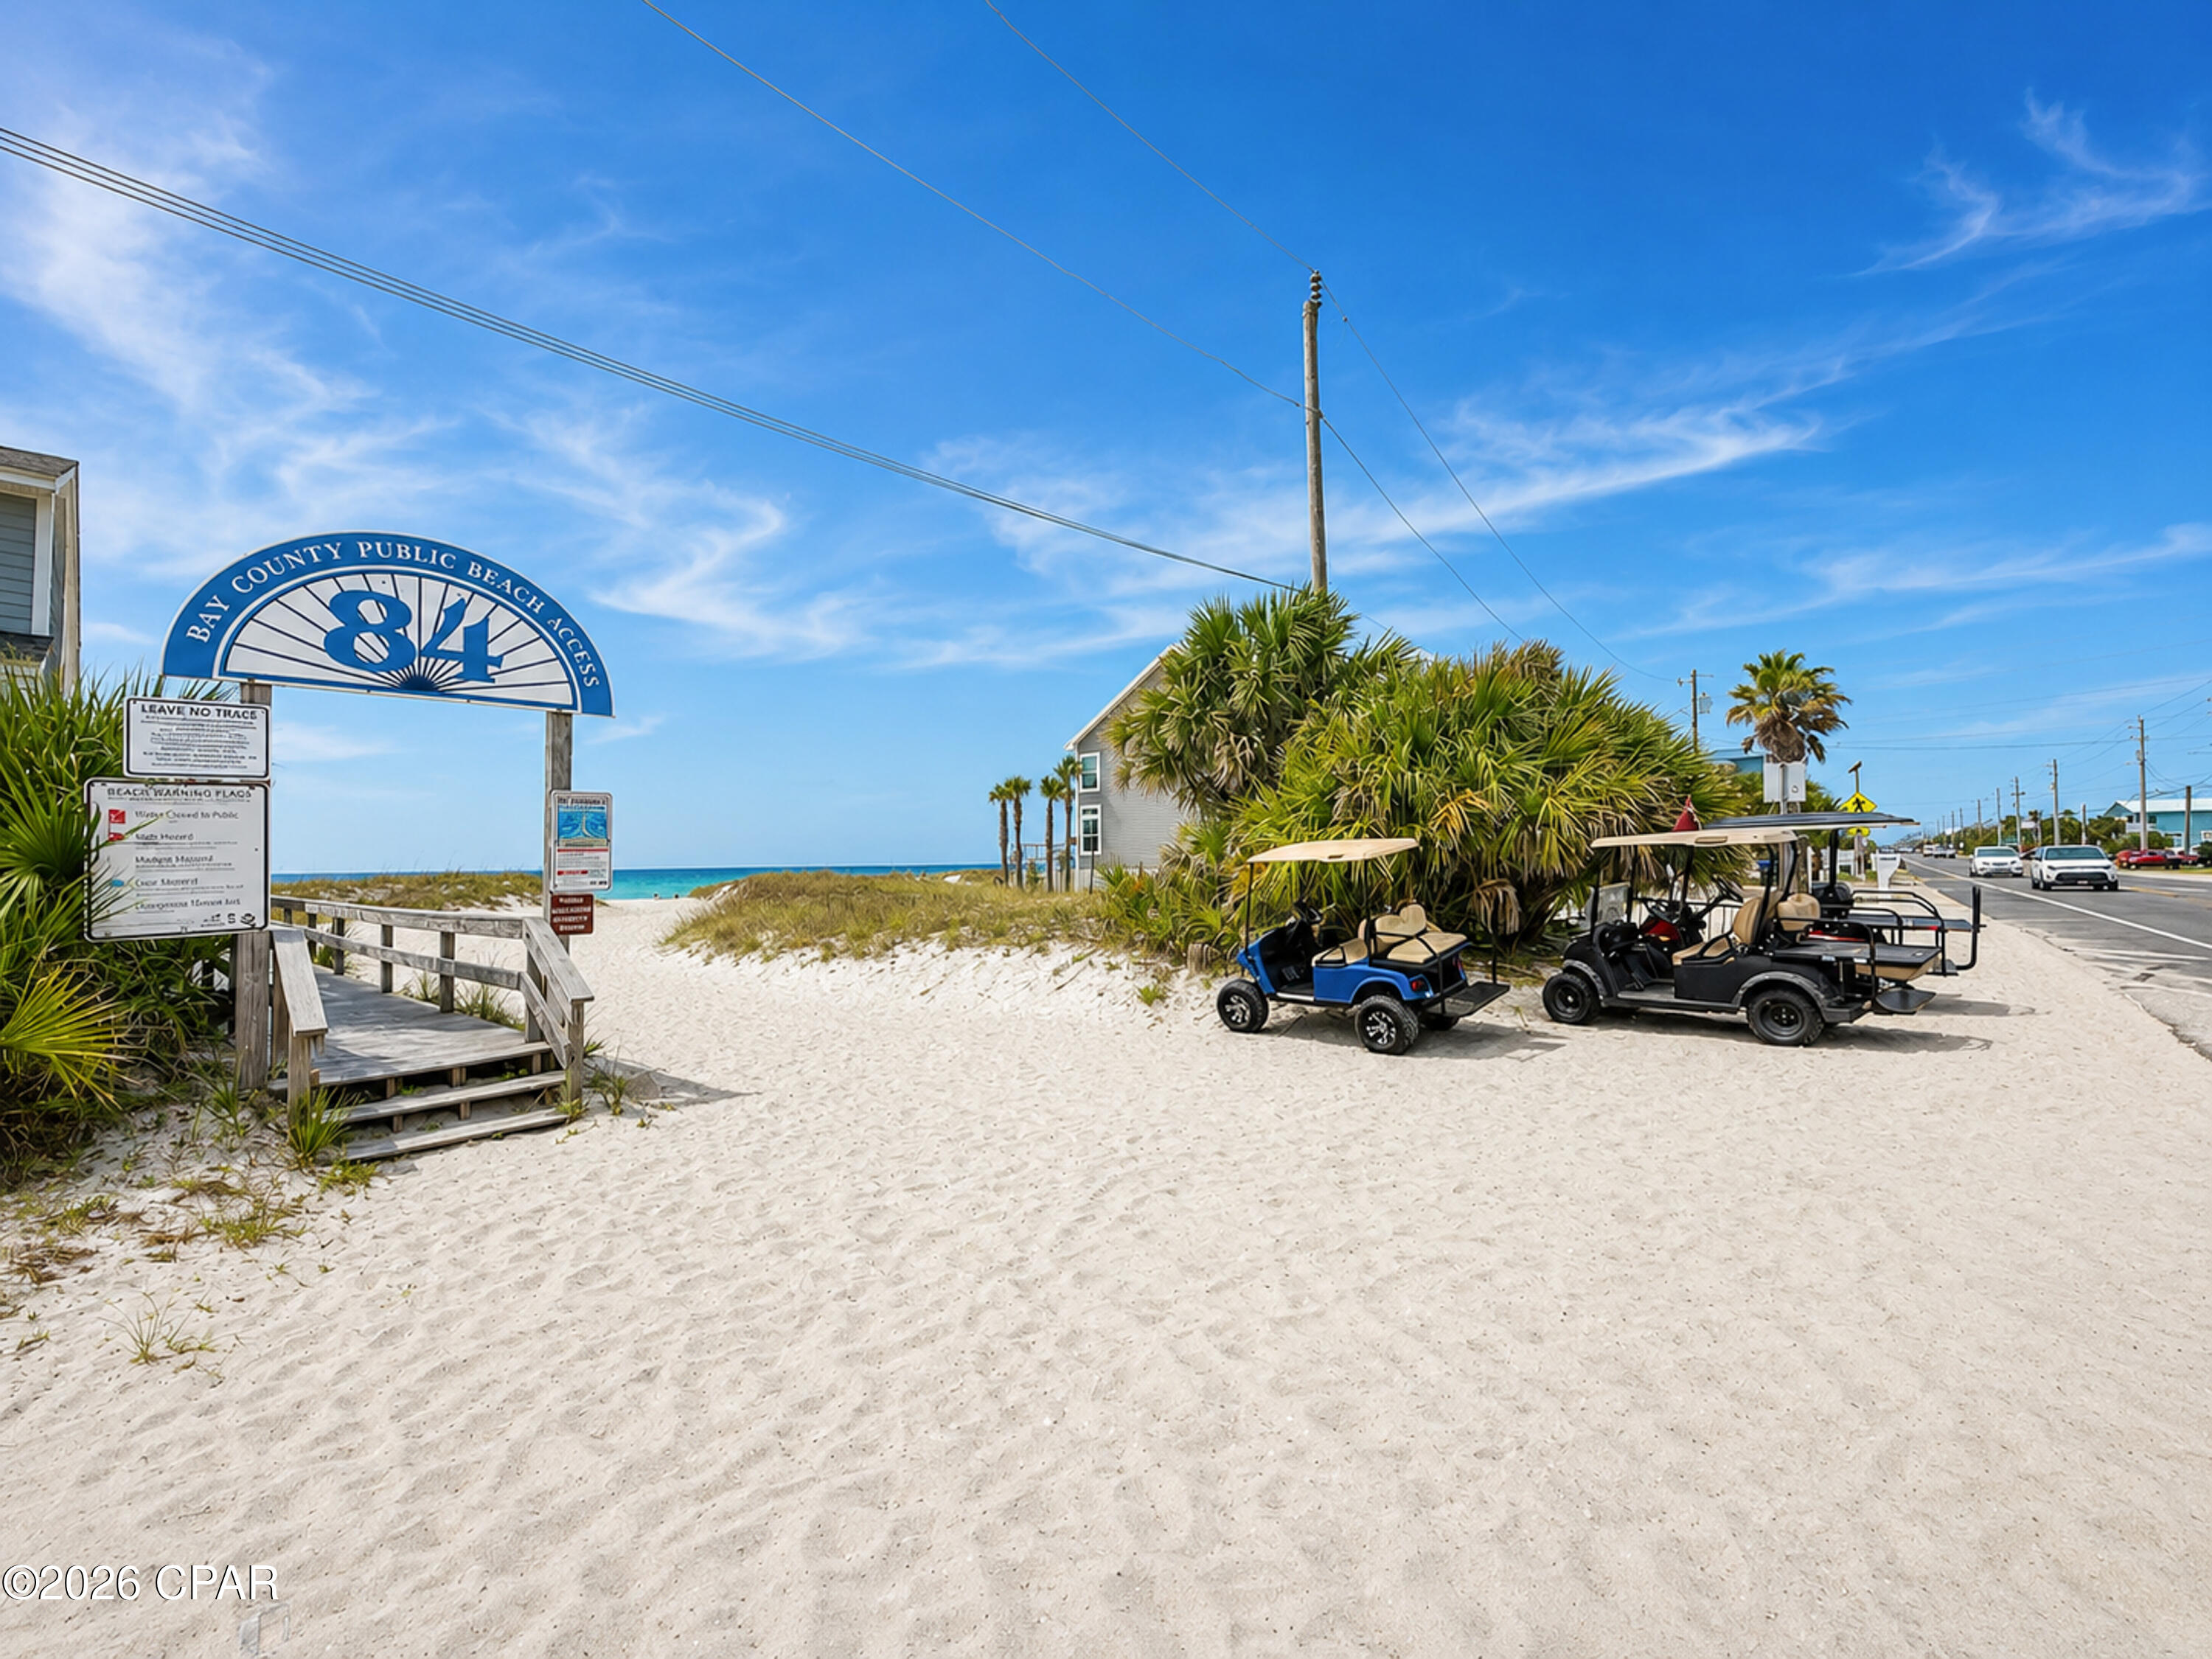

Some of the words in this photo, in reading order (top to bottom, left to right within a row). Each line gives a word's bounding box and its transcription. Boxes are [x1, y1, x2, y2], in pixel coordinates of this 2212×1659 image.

[186, 599, 231, 644] BAY
[232, 542, 344, 594] COUNTY
[358, 540, 456, 570] PUBLIC
[467, 560, 544, 615] BEACH
[548, 617, 599, 689] ACCESS
[323, 590, 504, 684] 84
[141, 704, 185, 715] LEAVE
[189, 707, 211, 717] NO
[215, 709, 257, 720] TRACE
[153, 789, 212, 799] WARNING
